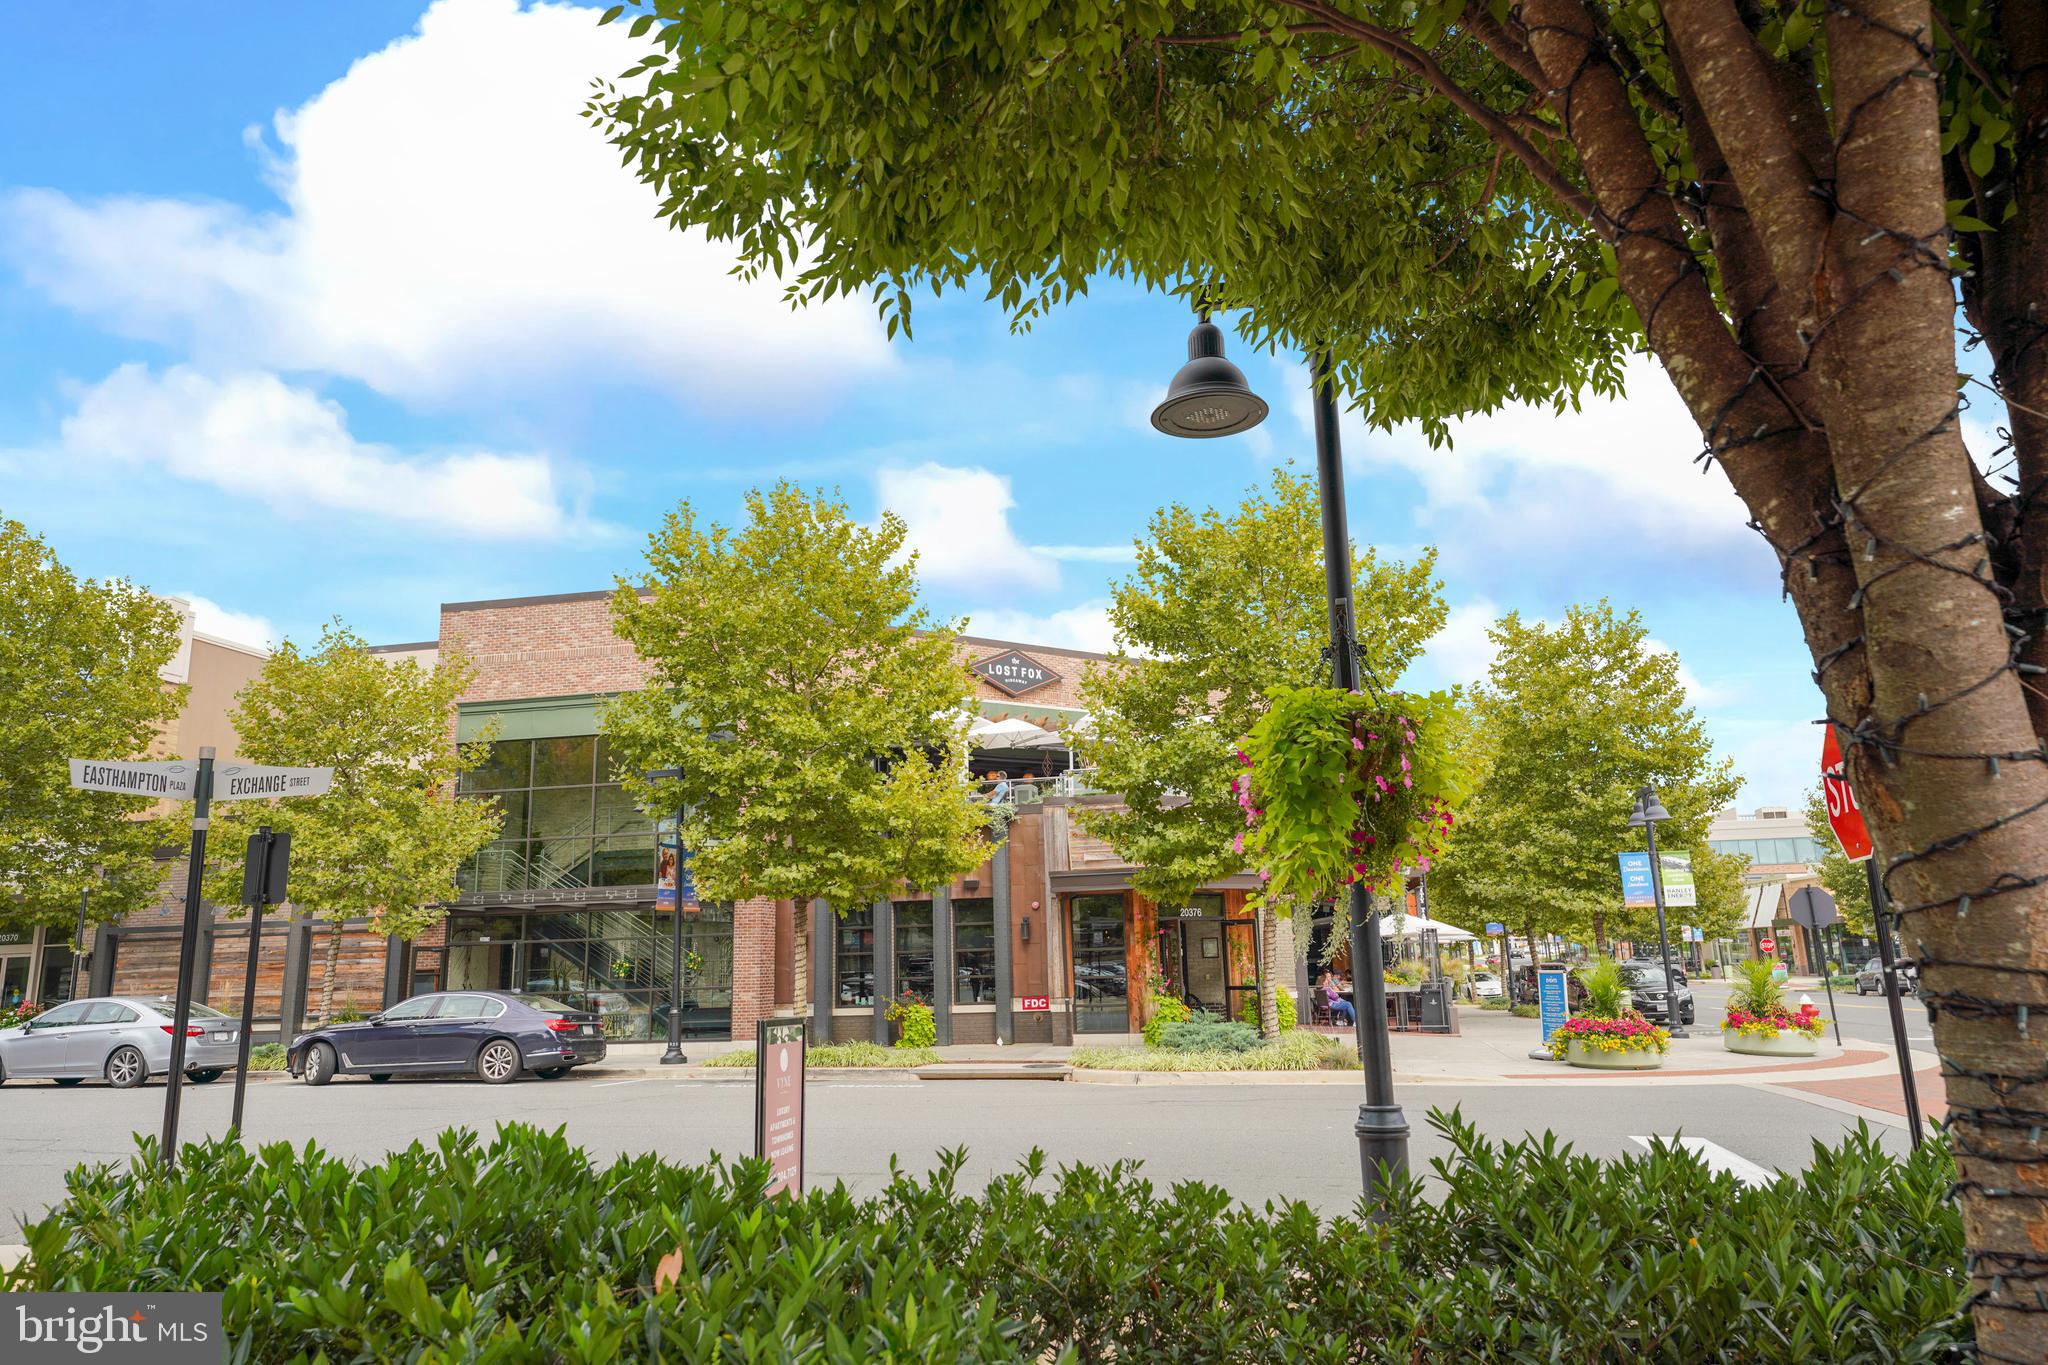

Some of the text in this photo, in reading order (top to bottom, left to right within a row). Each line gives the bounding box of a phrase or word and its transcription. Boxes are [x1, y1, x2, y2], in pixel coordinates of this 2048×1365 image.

[988, 663, 1042, 680] LOST FOX
[83, 764, 186, 793] EASTHAMPTON PLAZA
[230, 774, 311, 796] EXCHANGE STREET
[1179, 908, 1202, 917] 20376
[0, 934, 19, 942] 0370
[1024, 999, 1047, 1008] FDC
